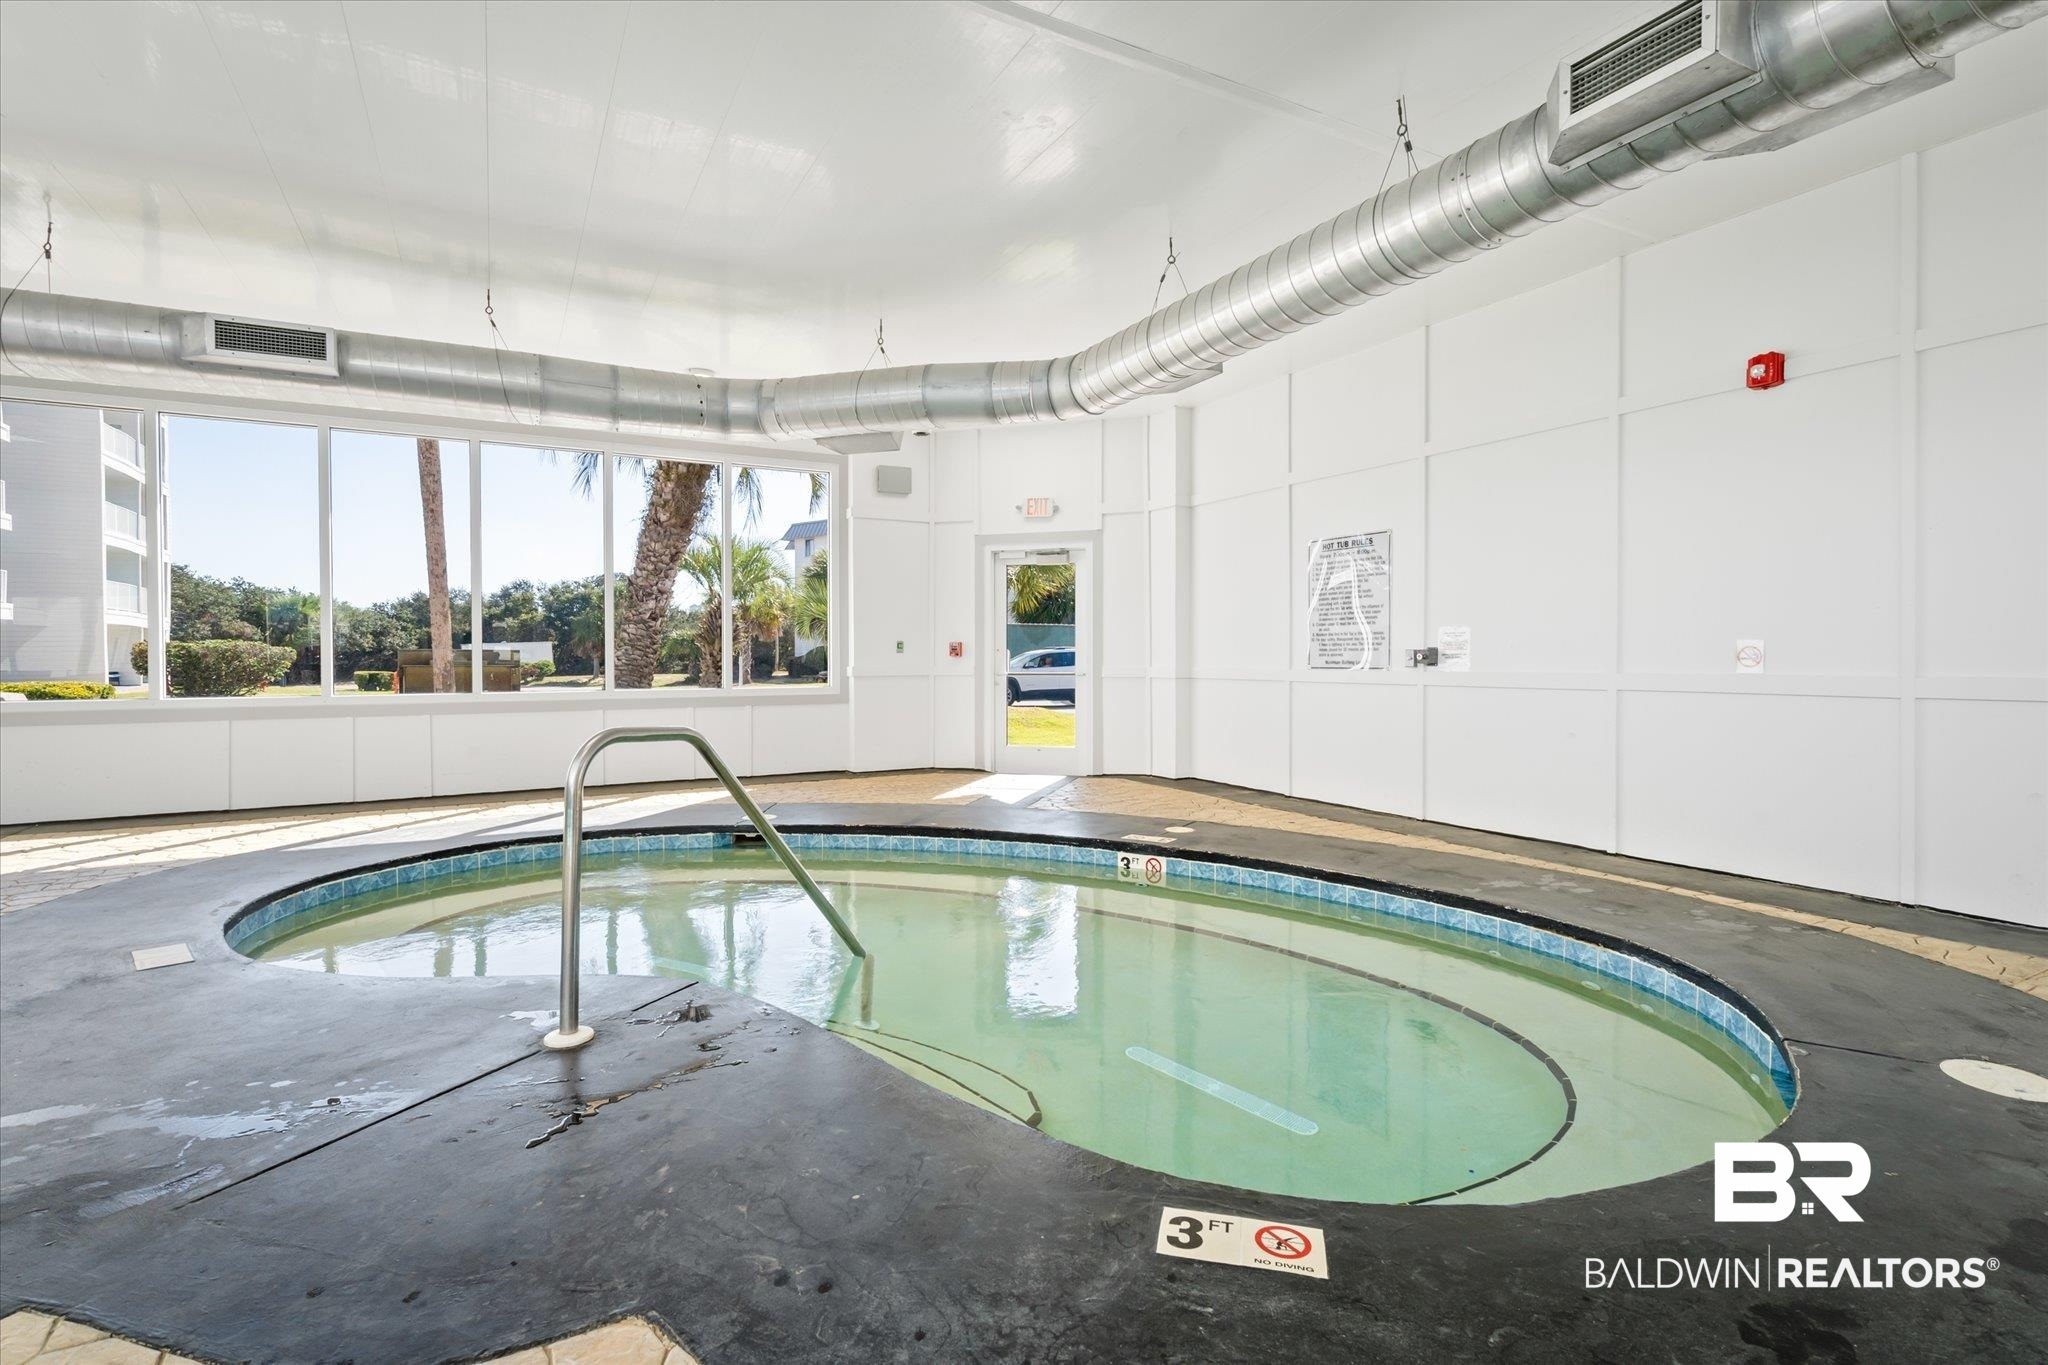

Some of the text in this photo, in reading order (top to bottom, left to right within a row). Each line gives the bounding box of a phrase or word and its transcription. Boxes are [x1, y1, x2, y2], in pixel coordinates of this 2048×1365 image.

[1027, 497, 1049, 515] EXIT
[1322, 542, 1335, 550] HOT
[1337, 540, 1350, 548] TUB
[1166, 1216, 1234, 1249] 3 FT
[1254, 1258, 1315, 1273] NO DIVING
